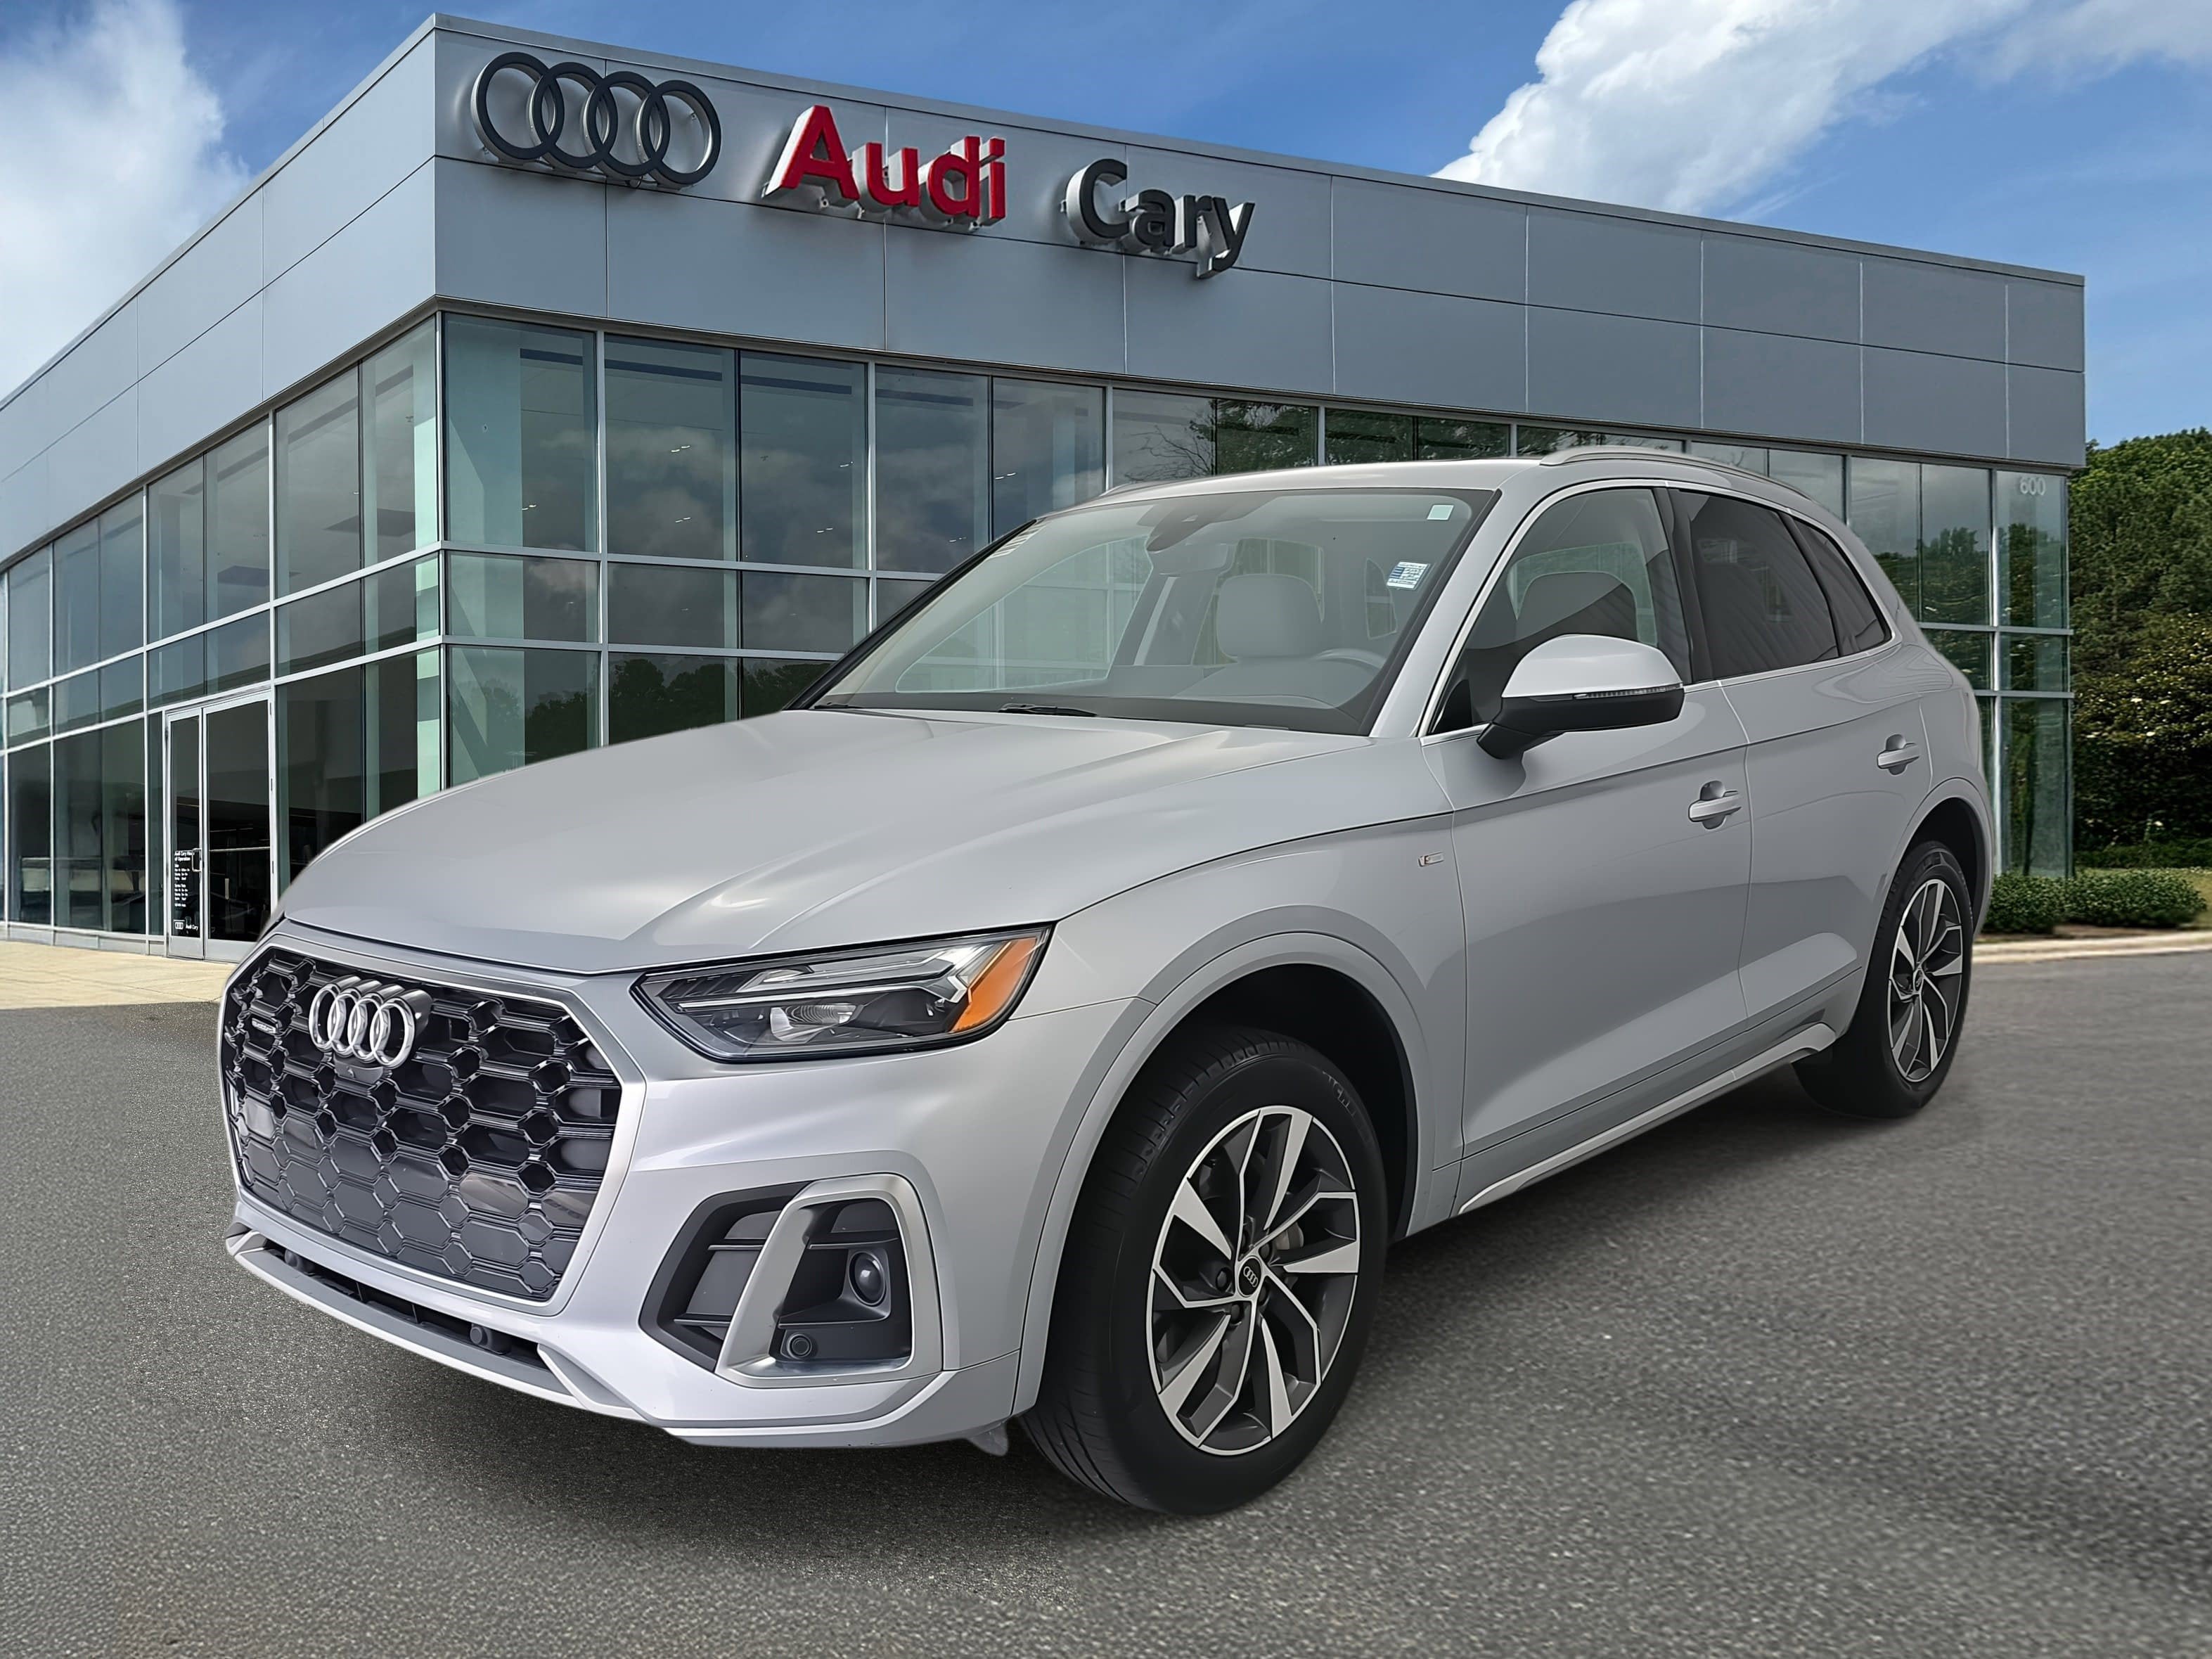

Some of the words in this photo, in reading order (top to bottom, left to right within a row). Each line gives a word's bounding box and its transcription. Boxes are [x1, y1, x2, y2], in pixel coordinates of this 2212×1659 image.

[772, 105, 1006, 221] Audi
[1067, 158, 1256, 277] Cary
[2020, 476, 2046, 496] 600
